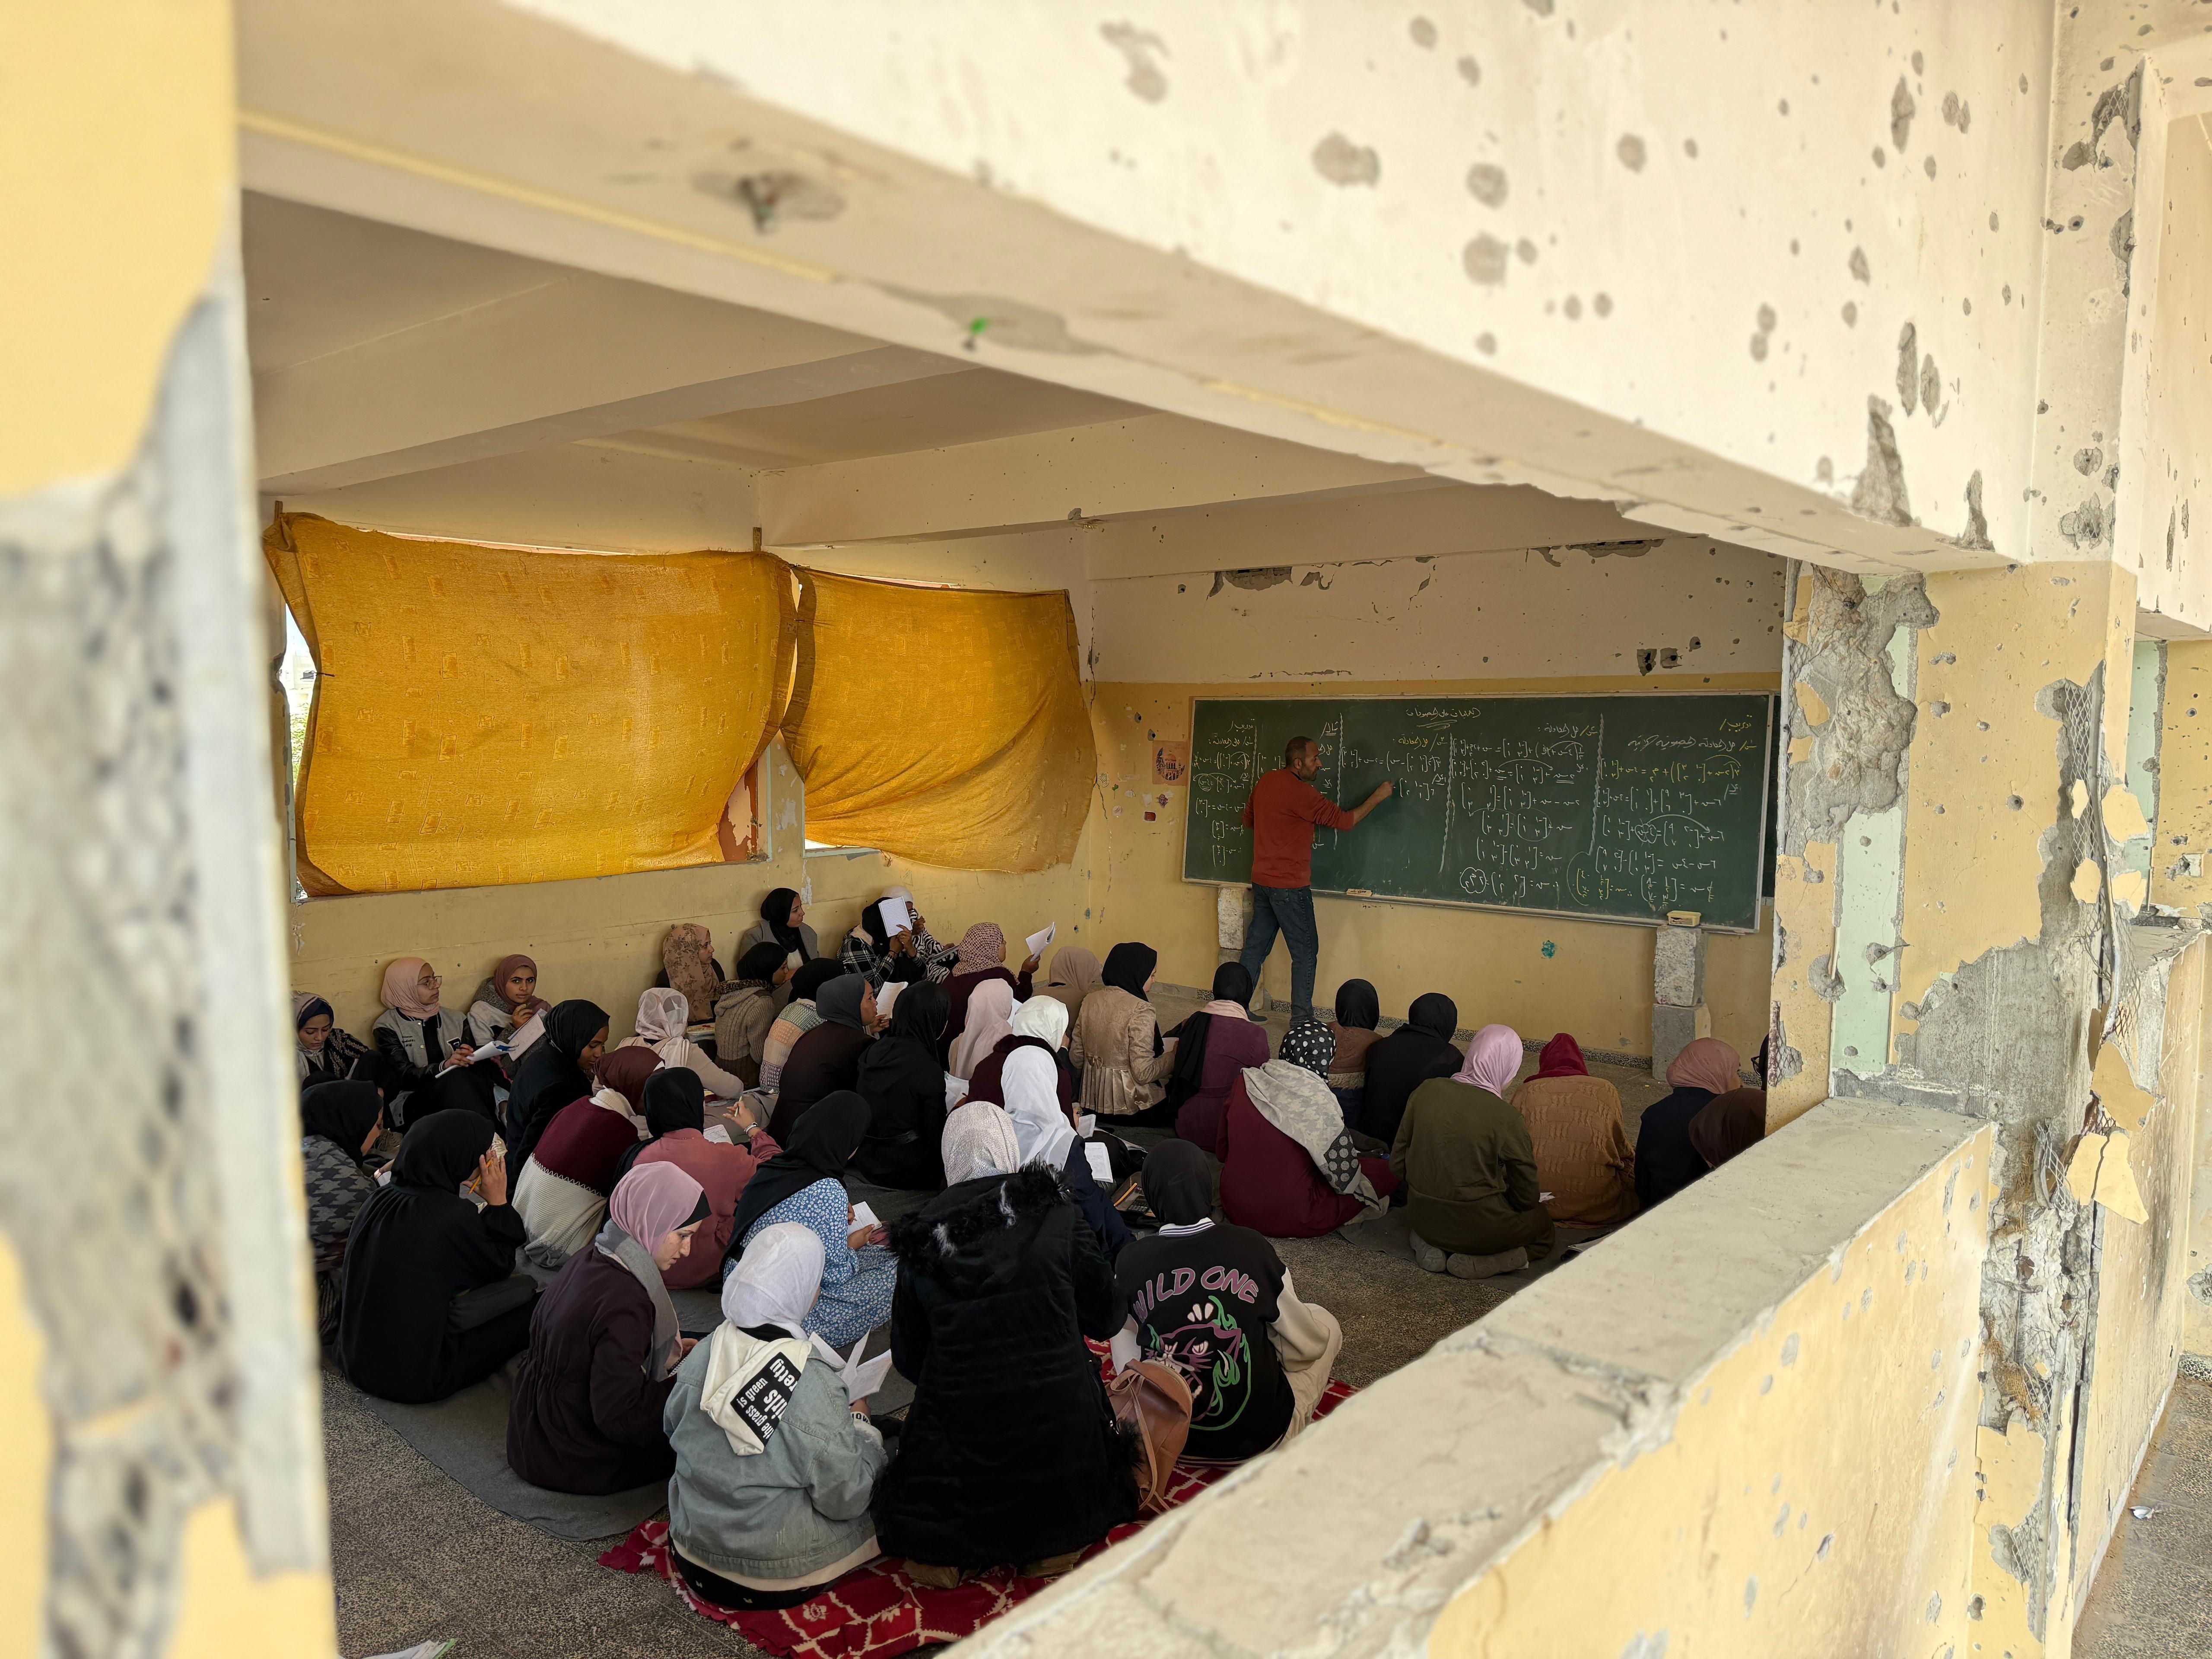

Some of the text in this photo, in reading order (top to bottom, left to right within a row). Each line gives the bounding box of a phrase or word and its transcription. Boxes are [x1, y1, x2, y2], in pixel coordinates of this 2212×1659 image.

[1132, 1265, 1259, 1323] WILD ONE
[769, 1358, 798, 1392] retty
[736, 1377, 769, 1408] is green
[763, 1389, 788, 1421] irls
[745, 1405, 768, 1427] grass
